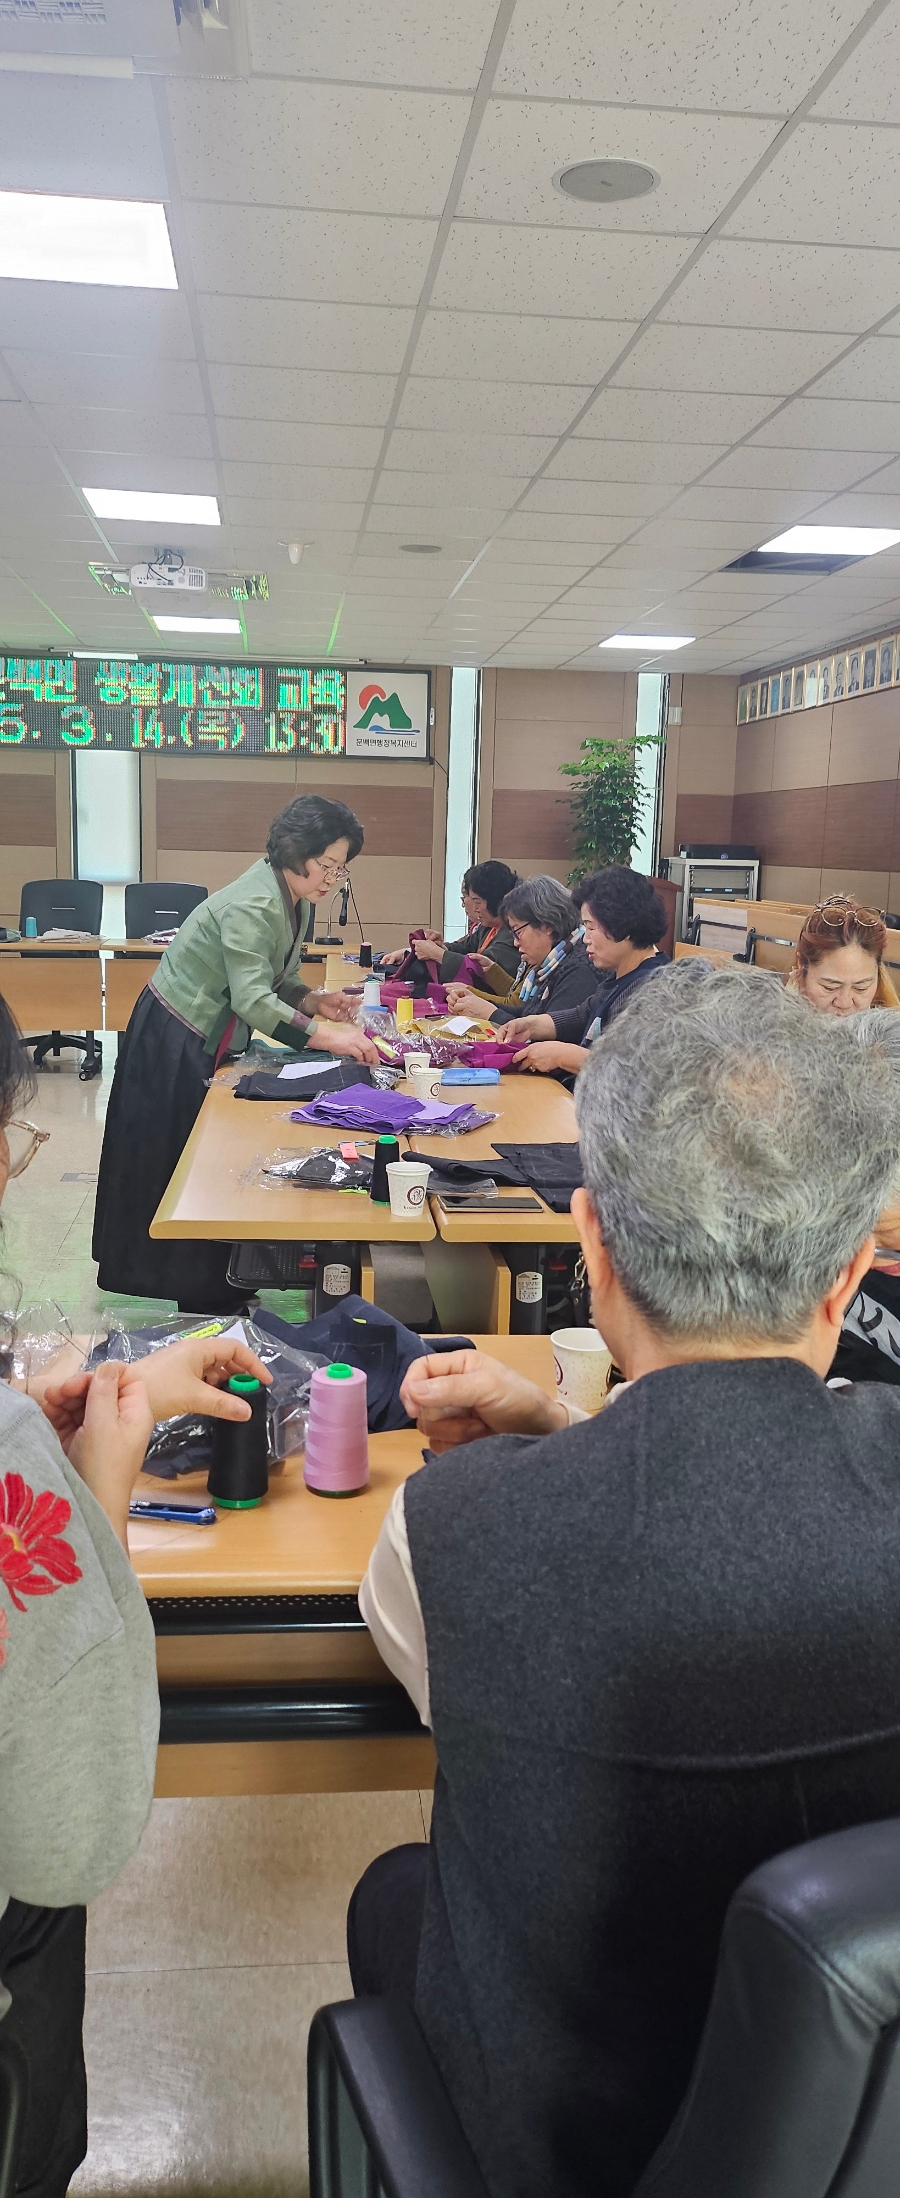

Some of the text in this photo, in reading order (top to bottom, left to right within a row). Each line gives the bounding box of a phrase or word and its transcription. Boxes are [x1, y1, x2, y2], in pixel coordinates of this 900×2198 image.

[0, 657, 345, 713] 백면 생활개선회 교육
[264, 711, 345, 754] 13:30
[356, 738, 418, 748] 문백면행정복지센터
